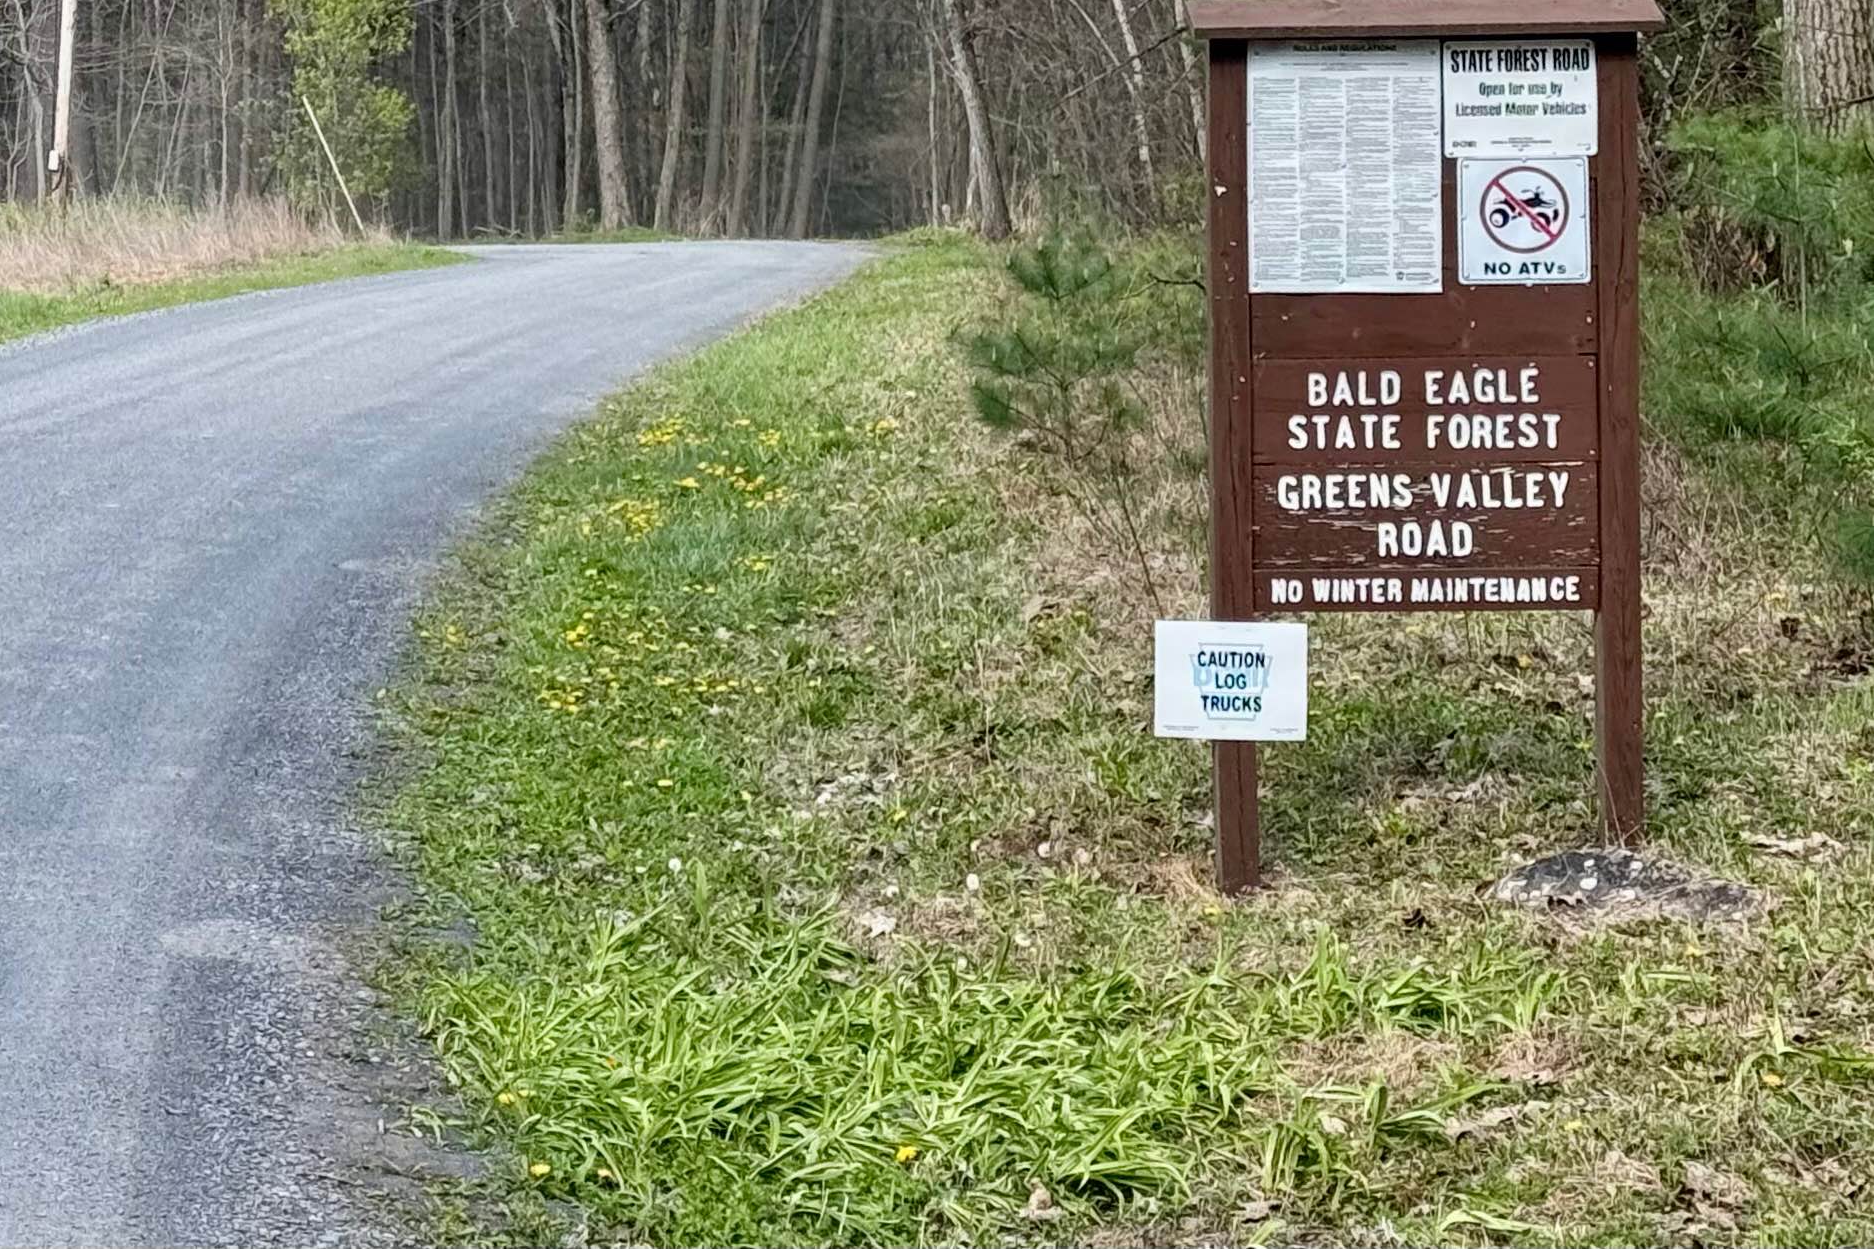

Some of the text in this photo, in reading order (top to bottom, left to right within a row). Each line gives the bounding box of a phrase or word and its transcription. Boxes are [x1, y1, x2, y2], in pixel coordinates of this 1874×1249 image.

[1451, 47, 1590, 73] STATE FOREST ROAD
[1479, 81, 1563, 97] Open for use by
[1455, 102, 1586, 116] Licensed Motor Vehicles
[1484, 261, 1567, 275] NO ATVs
[1307, 368, 1539, 407] BALD EAGLE
[1287, 413, 1562, 449] STATE FOREST
[1277, 471, 1569, 510] GREENS VALLEY
[1377, 519, 1473, 557] ROAD
[1271, 576, 1580, 603] NO WINTER MAINTENANCE
[1197, 650, 1265, 669] CAUTION
[1215, 672, 1247, 689] LOG
[1201, 695, 1262, 712] TRUCKS
